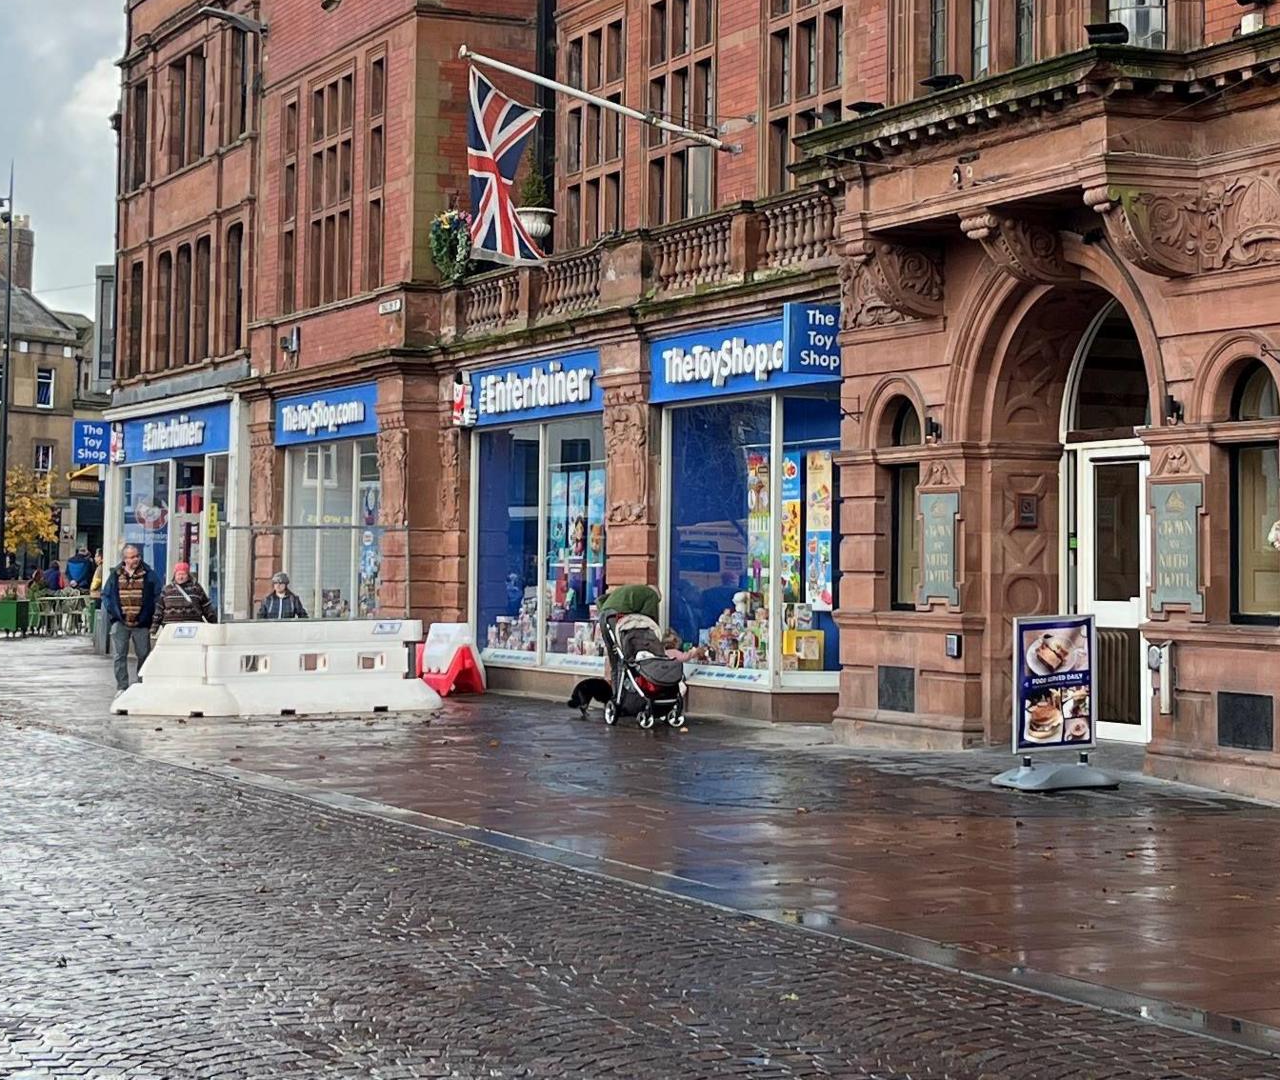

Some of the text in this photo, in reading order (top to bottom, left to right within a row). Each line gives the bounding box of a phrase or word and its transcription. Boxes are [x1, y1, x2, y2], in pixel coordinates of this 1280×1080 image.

[807, 310, 834, 326] The
[807, 331, 833, 349] Toy
[800, 351, 840, 370] Shop
[486, 360, 594, 414] Entertainer
[281, 400, 365, 436] TheToyShop.com
[82, 424, 104, 436] The
[83, 436, 103, 451] Toy
[77, 448, 108, 461] Shop
[1066, 672, 1083, 681] DAILY
